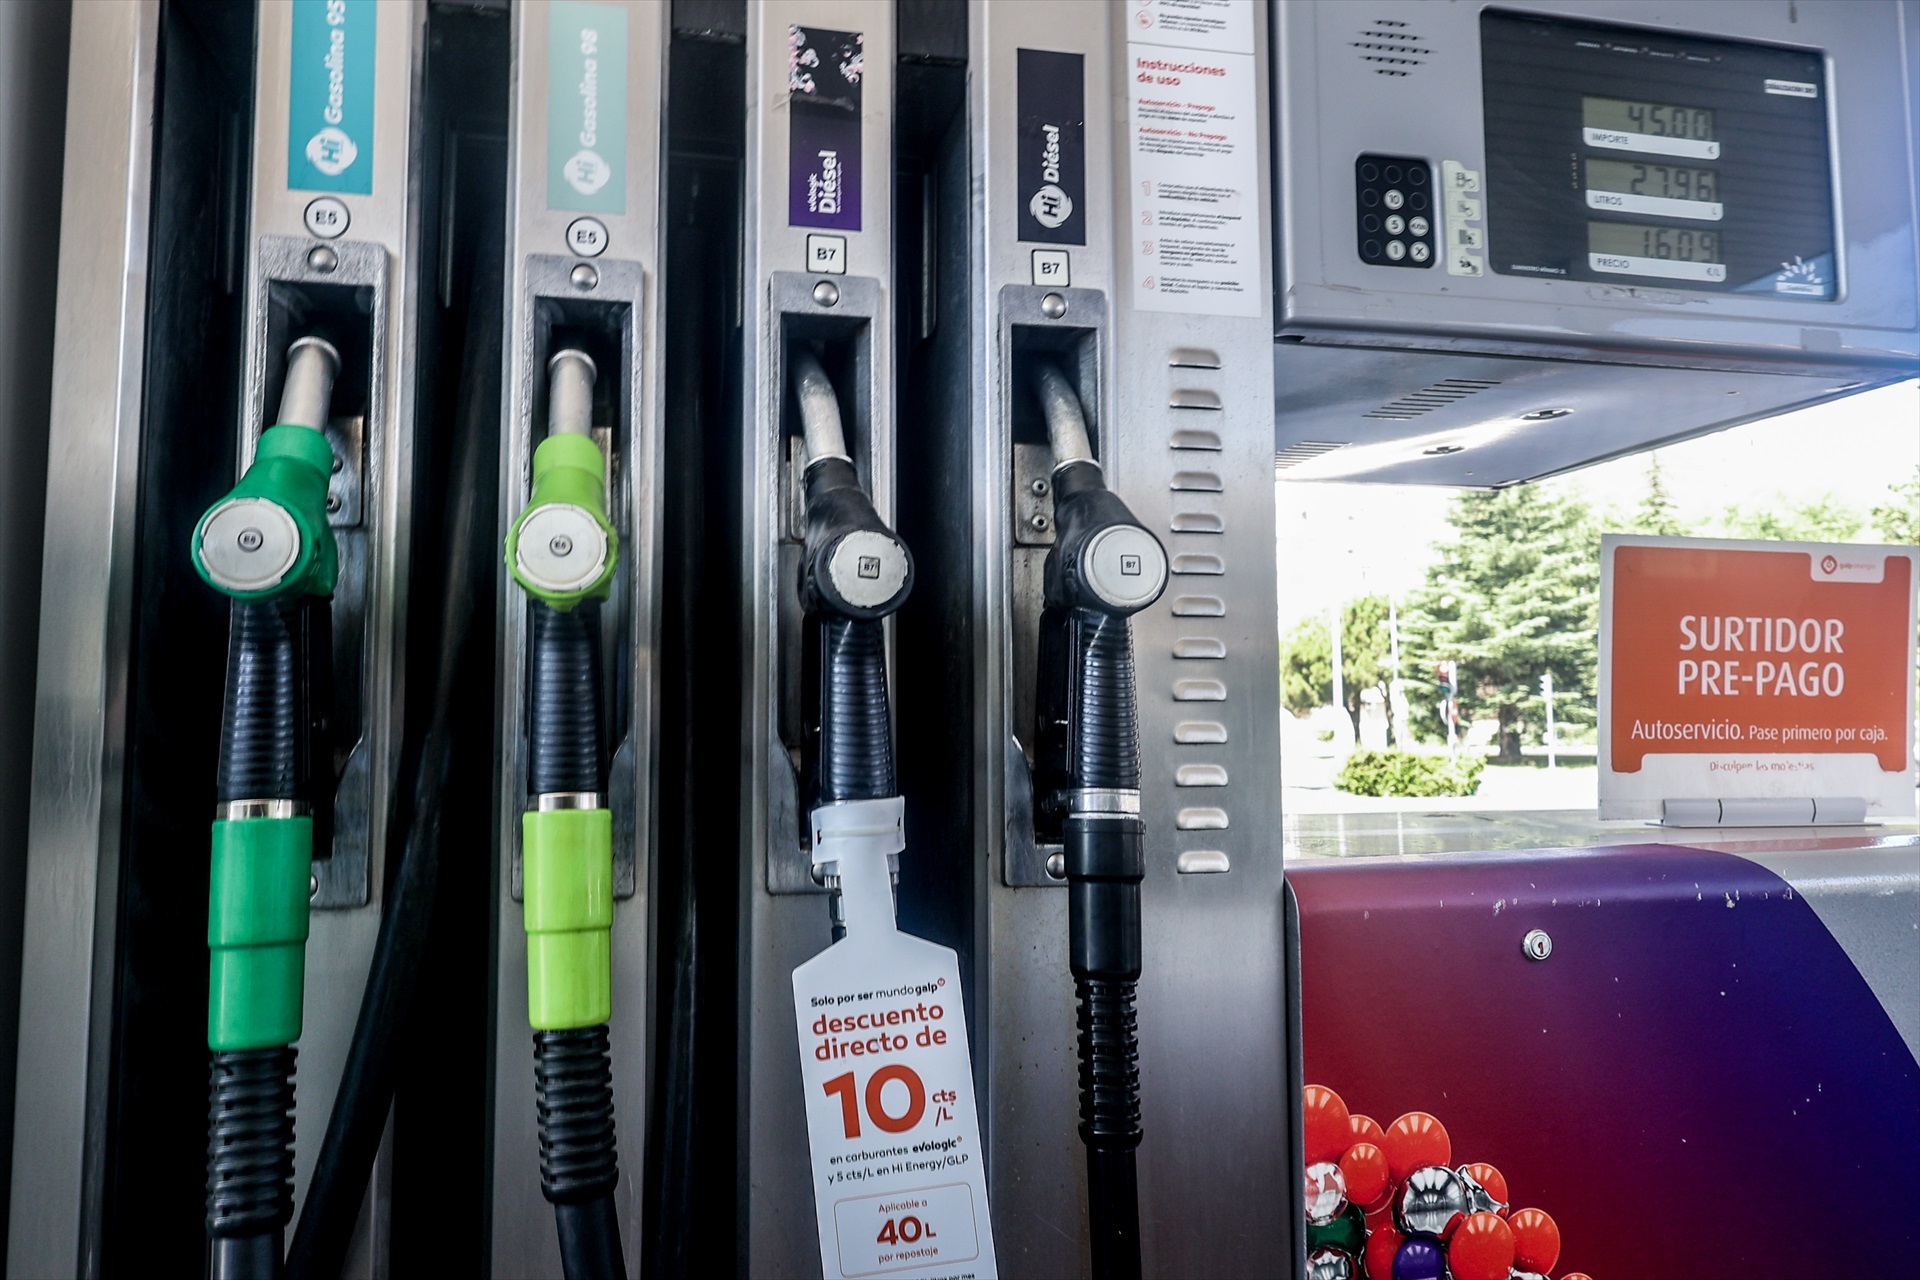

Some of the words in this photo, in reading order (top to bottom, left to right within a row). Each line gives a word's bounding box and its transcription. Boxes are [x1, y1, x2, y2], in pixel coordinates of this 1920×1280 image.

[326, 0, 346, 26] 95
[580, 28, 598, 55] 98
[324, 28, 345, 125] Gasolina
[1136, 57, 1227, 77] Instrucciones
[1137, 72, 1154, 84] de
[1156, 75, 1181, 86] uso
[579, 58, 598, 148] Gasolina
[1591, 132, 1629, 145] IMPORTE
[1041, 123, 1060, 184] Diésel
[818, 149, 837, 214] Diésel
[1041, 194, 1059, 219] Hi
[1594, 195, 1623, 206] LITROS
[315, 210, 338, 226] E5
[1141, 211, 1153, 226] 2
[1391, 220, 1399, 230] 5
[576, 229, 597, 245] E5
[817, 248, 837, 261] B7
[1142, 240, 1154, 256] 3
[1393, 244, 1399, 255] 1
[1042, 262, 1061, 275] B7
[1597, 257, 1630, 269] PRECIO
[1142, 275, 1155, 290] 4
[1125, 561, 1136, 569] B7
[1679, 615, 1845, 654] SURTIDOR
[1678, 660, 1845, 697] PRE-PAGO
[1631, 718, 1746, 741] Autoservicio.
[1749, 724, 1779, 741] Pase
[1782, 724, 1832, 744] primero
[1835, 727, 1856, 744] por
[1859, 725, 1889, 744] caja.
[810, 996, 835, 1008] Solo
[837, 993, 855, 1007] por
[857, 992, 874, 1002] ser
[812, 1002, 944, 1036] descuento
[815, 1032, 909, 1062] directo
[915, 1025, 948, 1047] de
[822, 1064, 926, 1140] 10
[931, 1088, 957, 1103] cts
[935, 1106, 954, 1127] /L
[829, 1156, 843, 1166] en
[845, 1146, 909, 1164] carburantes
[827, 1174, 835, 1186] y
[836, 1171, 844, 1182] 5
[846, 1166, 874, 1182] cts/L
[876, 1166, 890, 1177] en
[892, 1162, 904, 1174] Hi
[905, 1153, 969, 1173] Energy/GLP
[878, 1200, 920, 1215] Aplicable
[921, 1200, 928, 1208] a
[878, 1253, 894, 1266] por
[895, 1246, 939, 1262] repostaje
